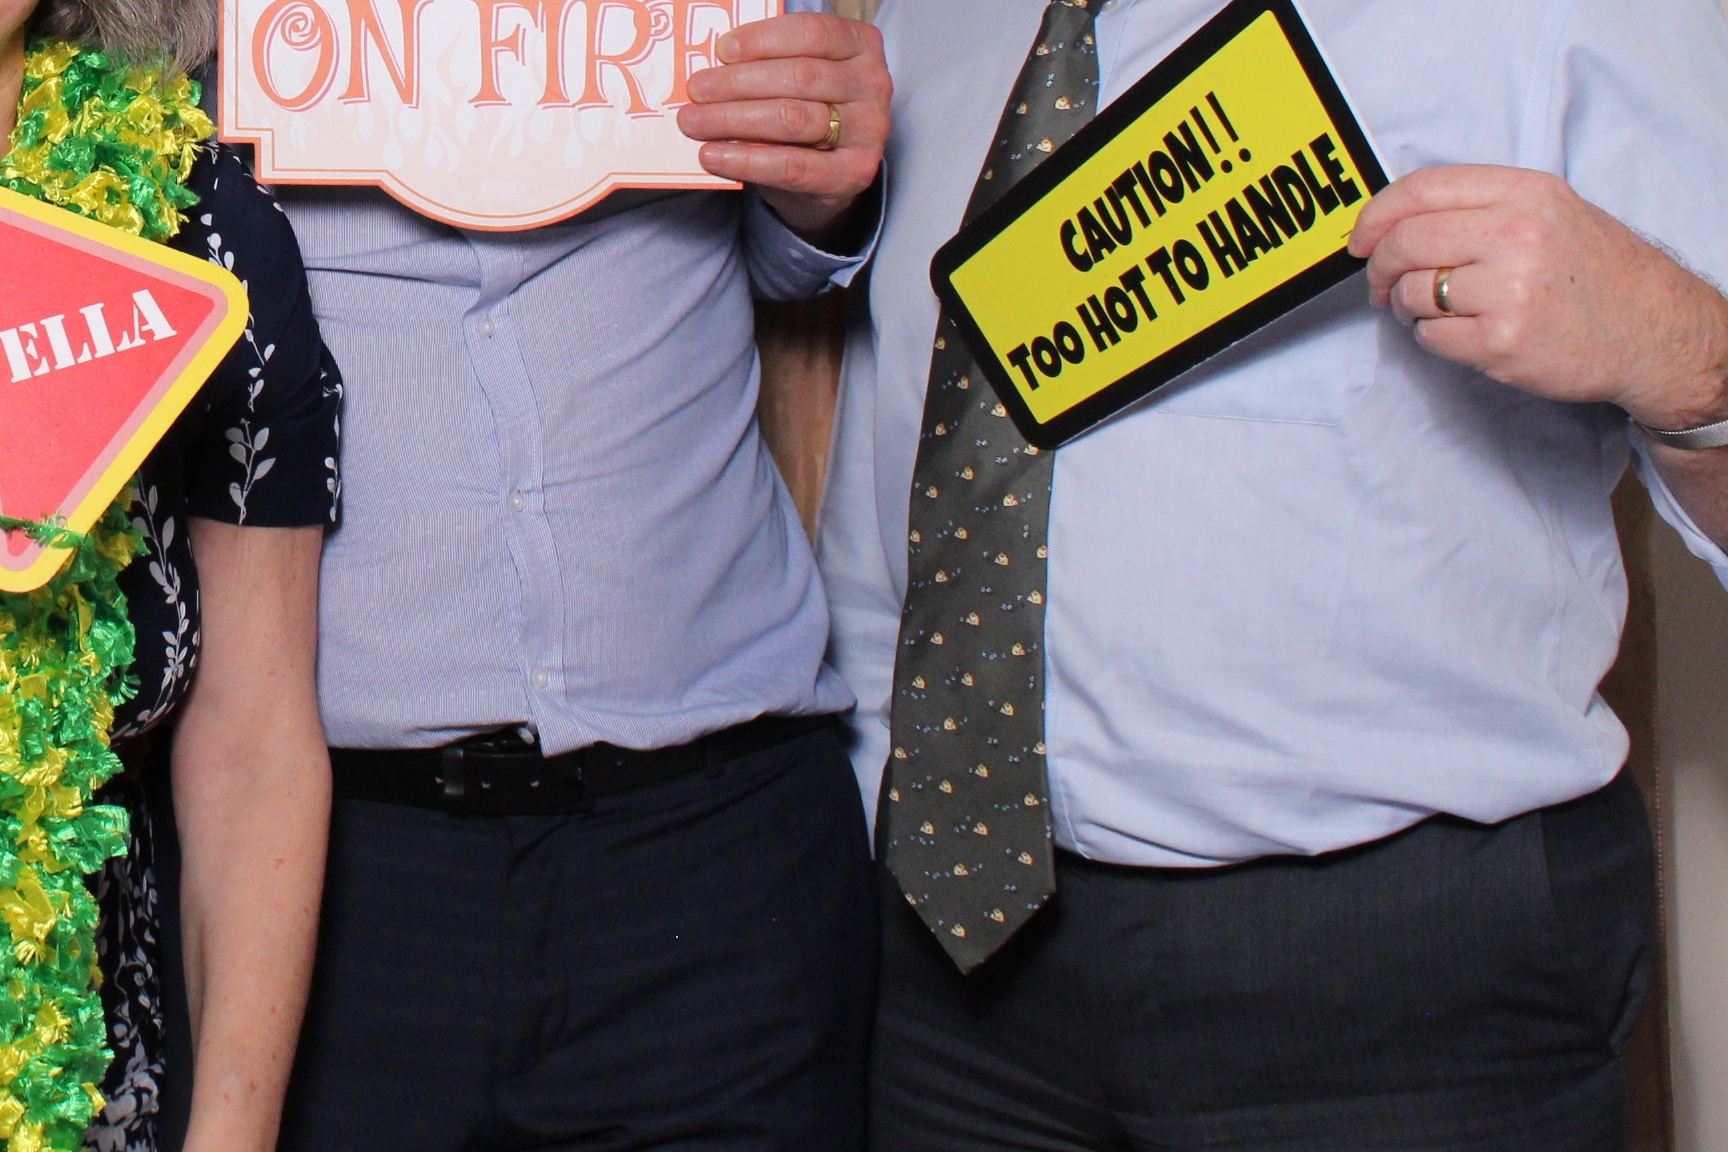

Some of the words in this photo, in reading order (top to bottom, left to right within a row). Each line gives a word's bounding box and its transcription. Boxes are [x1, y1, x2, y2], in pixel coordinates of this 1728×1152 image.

[1006, 321, 1085, 391] TOO
[1076, 265, 1159, 352] HOT
[1145, 239, 1210, 305] TO
[1196, 132, 1363, 279] HANDLE
[1059, 91, 1252, 273] CAUTION!!
